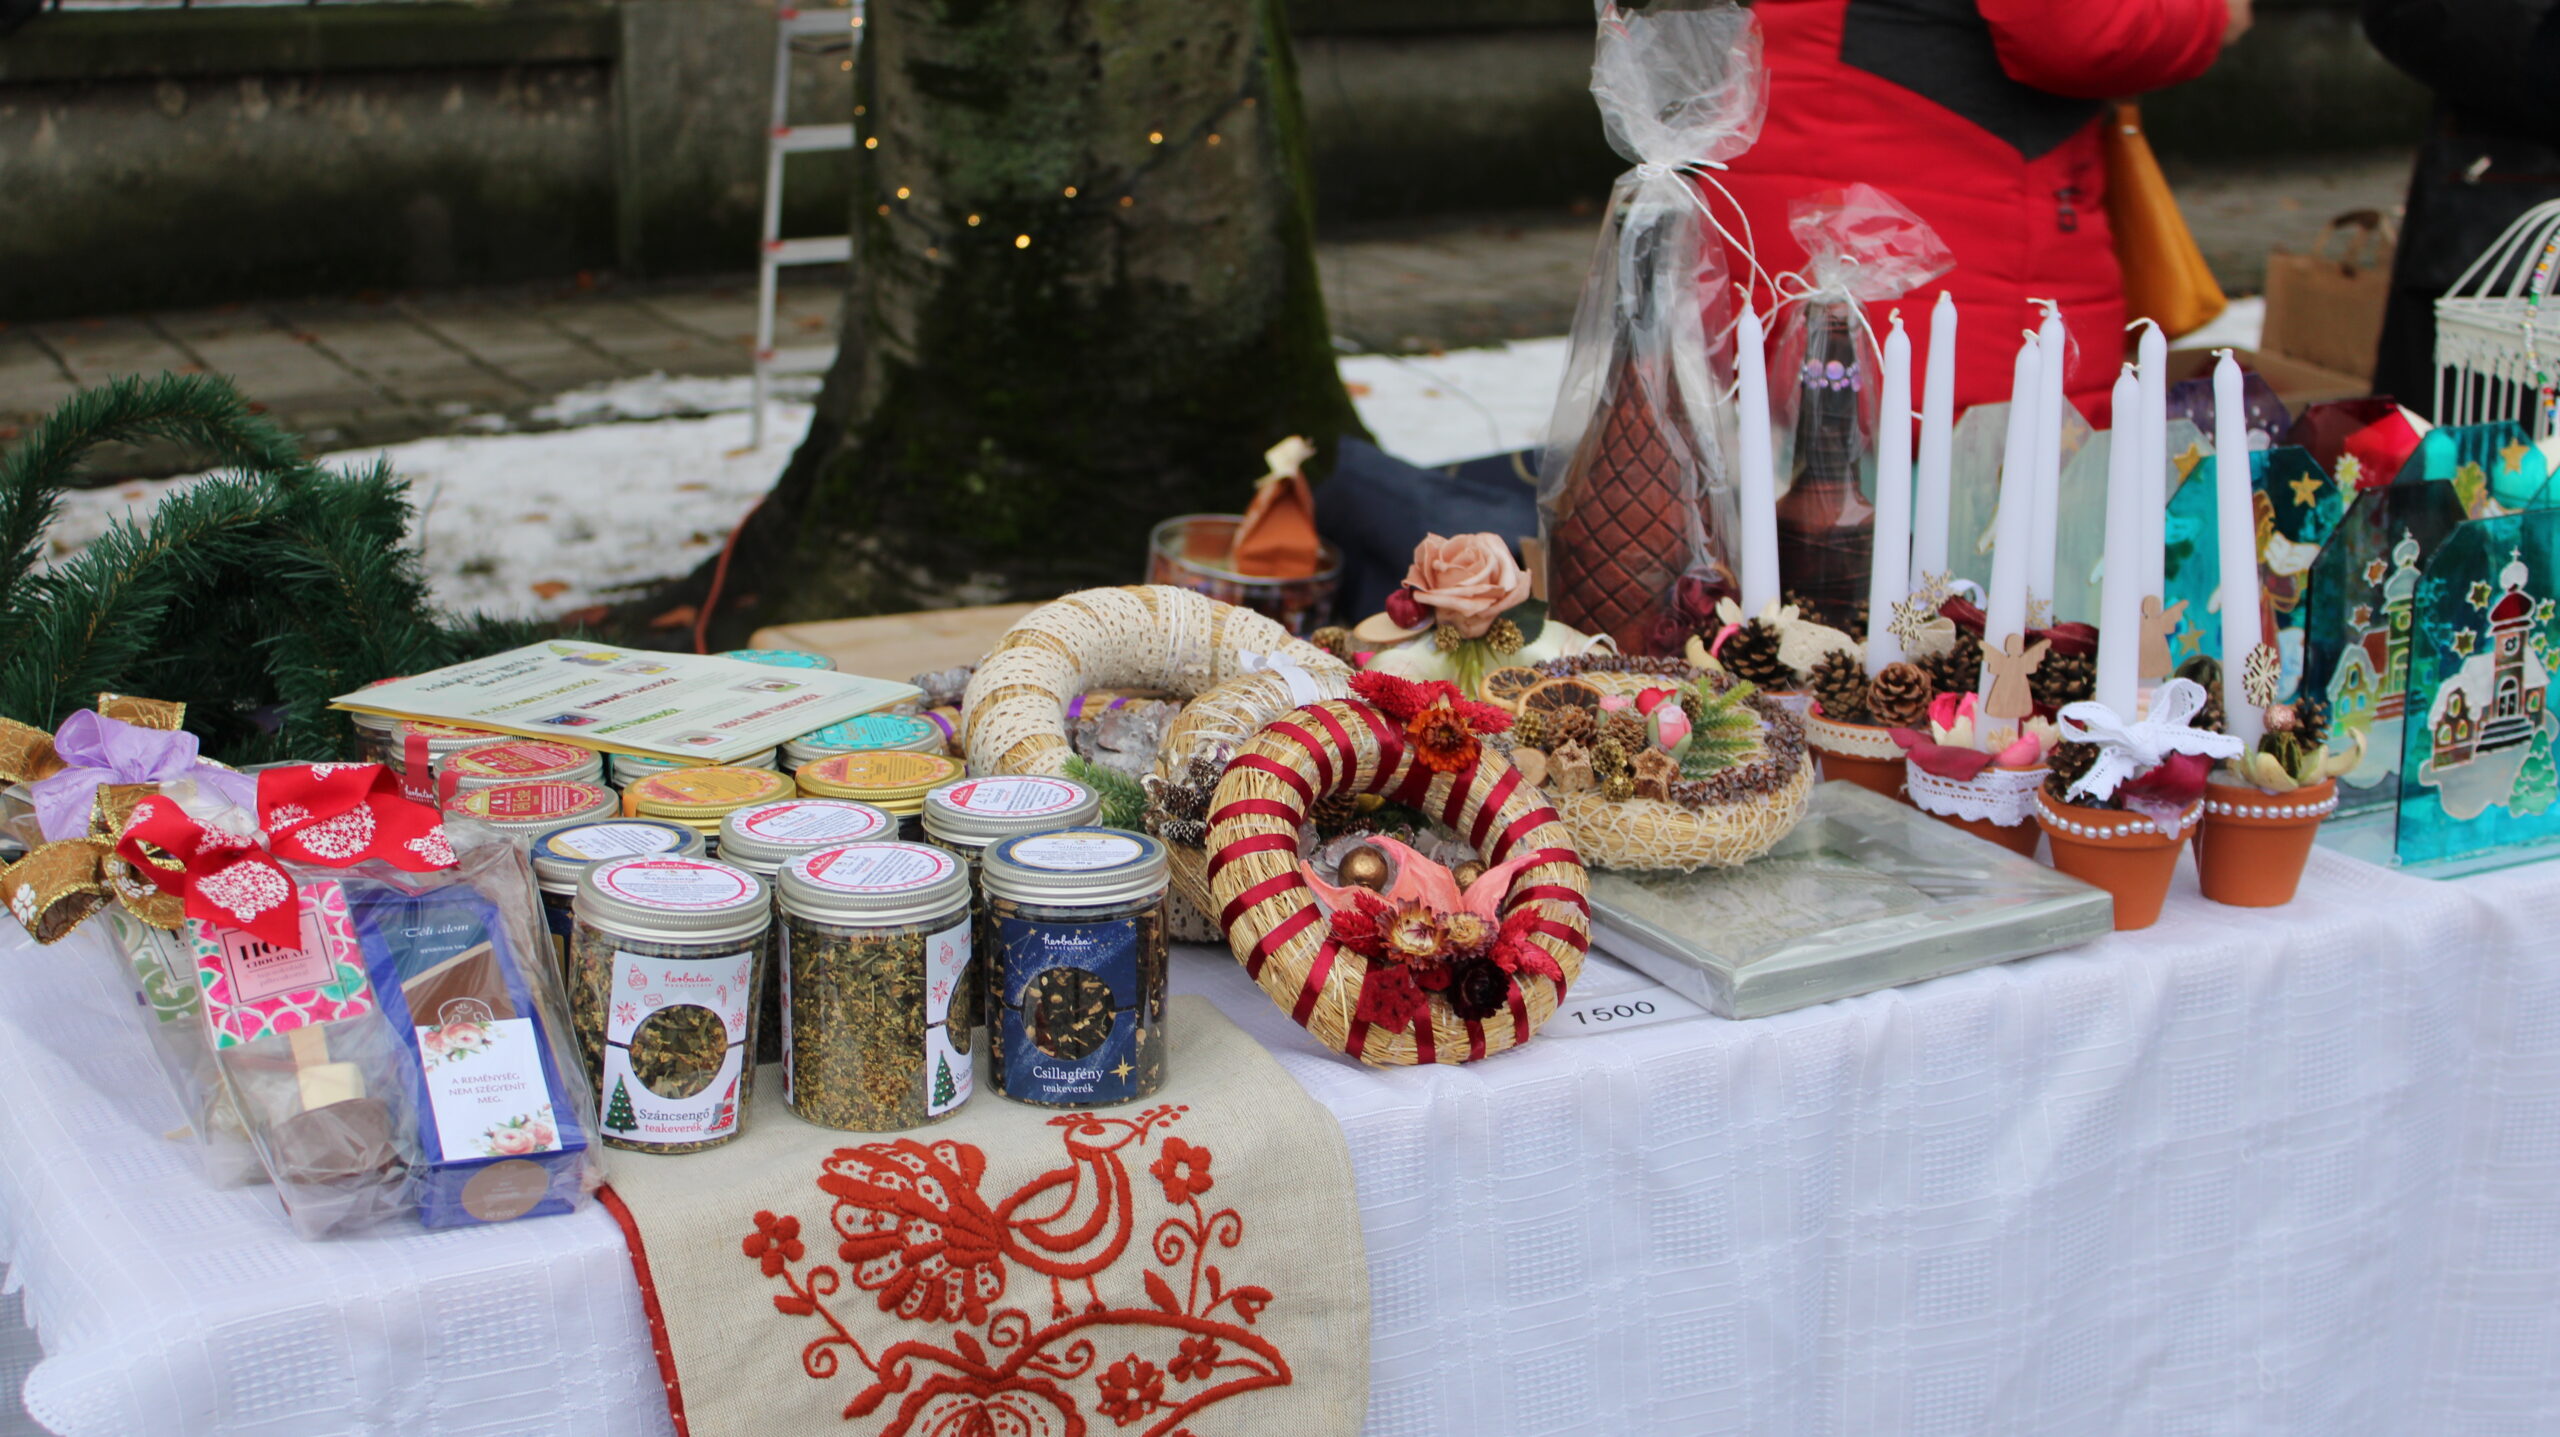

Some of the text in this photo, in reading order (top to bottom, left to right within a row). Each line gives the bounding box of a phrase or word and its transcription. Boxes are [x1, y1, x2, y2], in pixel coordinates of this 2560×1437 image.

[1041, 932, 1093, 946] herbatea
[240, 941, 282, 961] HO
[247, 949, 311, 969] CHOCOLATE
[1571, 1001, 1656, 1025] 1500
[452, 1072, 520, 1085] A REMÉNYSÉG
[1032, 1065, 1104, 1082] Csillagfény
[449, 1082, 527, 1096] NEM SZÉGYENÍT
[1042, 1083, 1094, 1093] teakeverék
[477, 1095, 502, 1105] MEG.
[639, 1107, 710, 1122] Száncsengő
[645, 1122, 703, 1133] teakeverék
